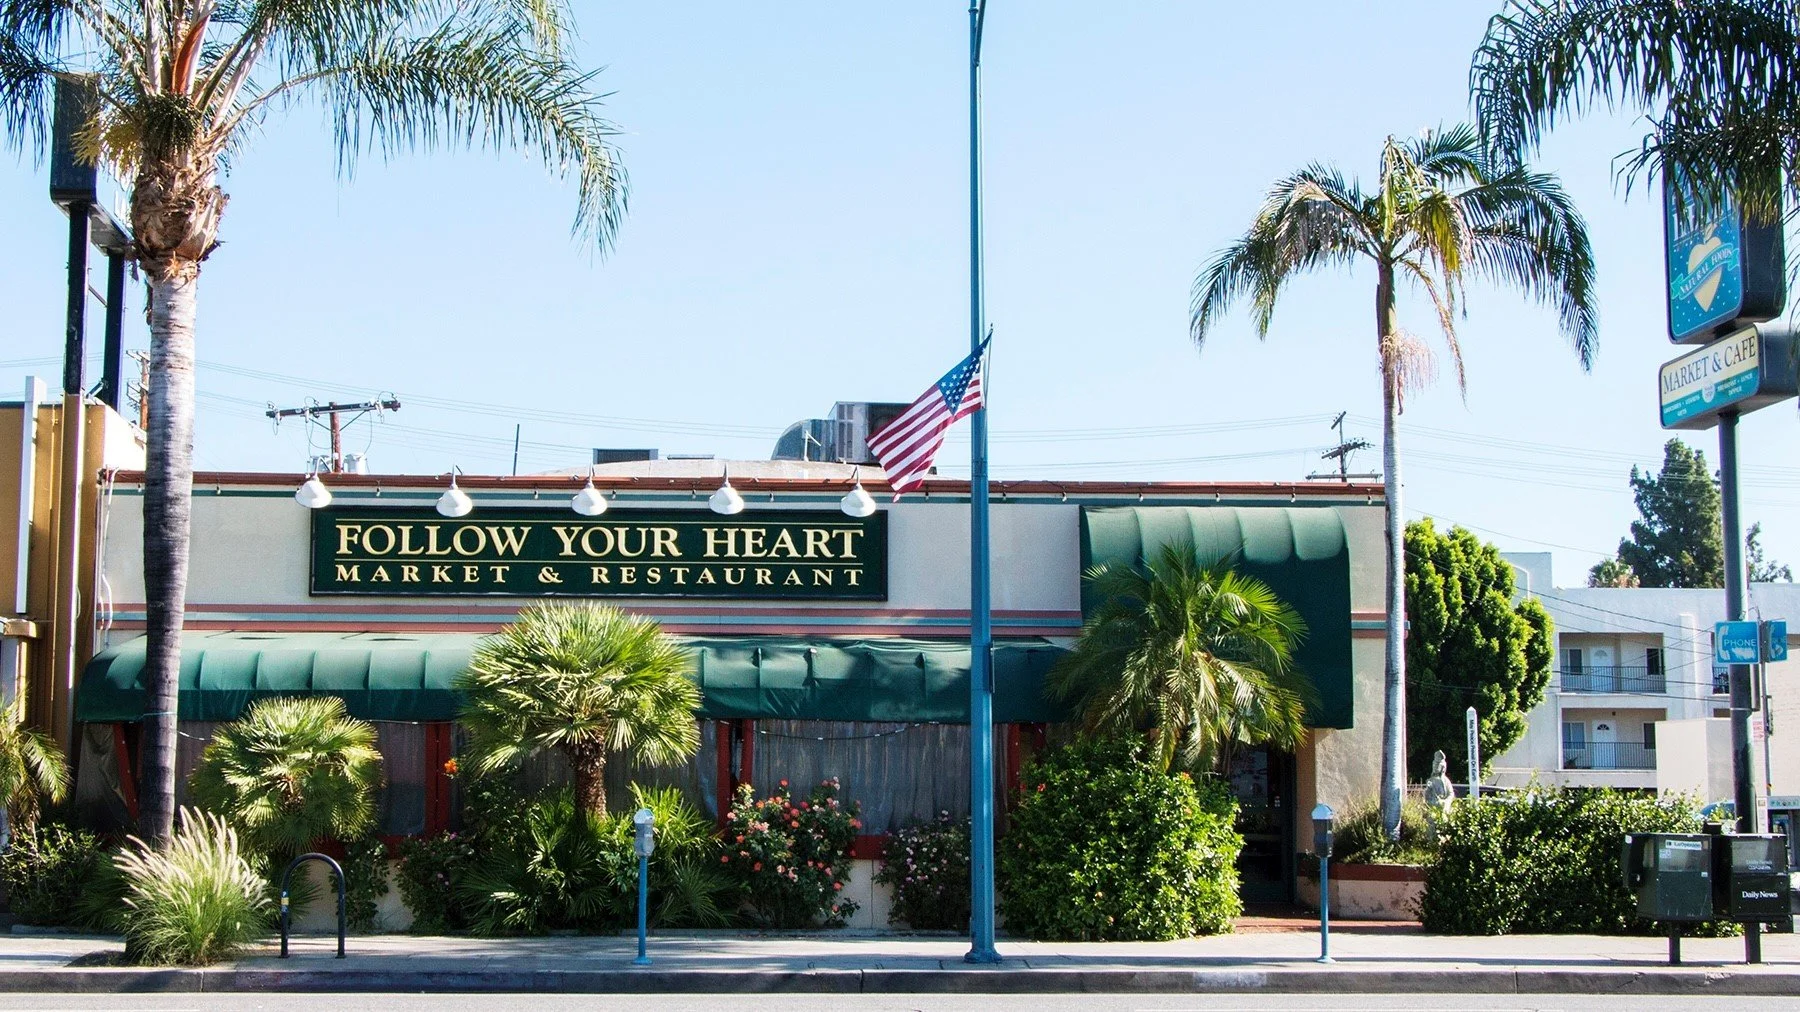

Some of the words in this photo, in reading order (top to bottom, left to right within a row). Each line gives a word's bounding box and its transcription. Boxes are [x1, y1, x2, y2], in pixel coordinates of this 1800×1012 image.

[1680, 263, 1709, 294] NATURAL
[1711, 247, 1732, 266] FOODS
[1663, 356, 1709, 394] MARKET
[1712, 352, 1722, 373] &
[1724, 335, 1756, 367] CAFE
[335, 524, 532, 556] FOLLOW
[552, 526, 682, 557] YOUR
[702, 528, 864, 558] HEART
[335, 564, 510, 583] MARKET
[538, 566, 563, 583] &
[591, 566, 864, 586] RESTAURANT
[1724, 639, 1757, 647] PHONE
[1741, 891, 1760, 899] Daily
